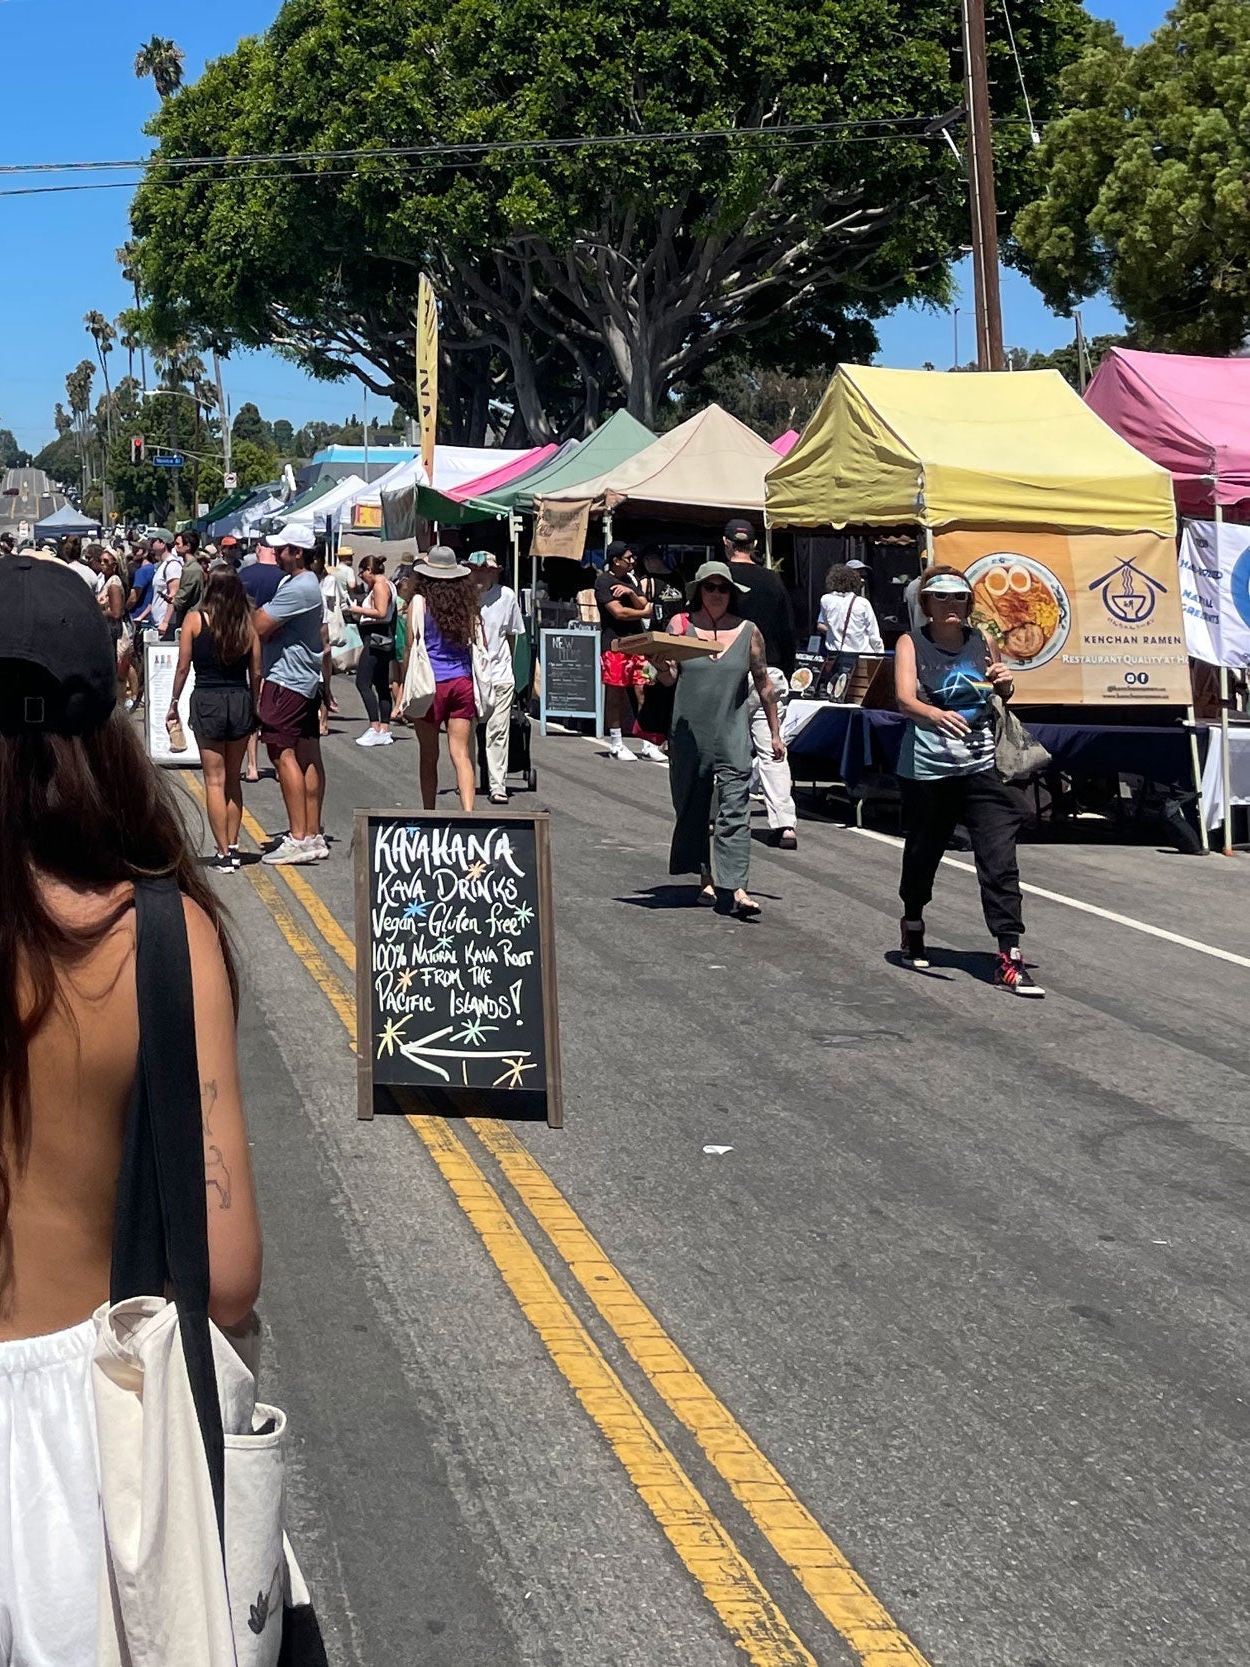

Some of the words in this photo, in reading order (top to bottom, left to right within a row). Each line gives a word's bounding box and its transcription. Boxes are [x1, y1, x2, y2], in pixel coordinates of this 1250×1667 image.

[552, 636, 574, 649] NEW
[1084, 635, 1139, 645] KENCHAN
[1143, 635, 1181, 645] RAMEN
[1062, 653, 1122, 664] RESTAURANT
[1123, 654, 1162, 667] QUALITY
[373, 820, 525, 878] KAVAHANA
[377, 868, 427, 904] KAVA
[432, 869, 518, 909] DRINKS
[485, 905, 522, 937] free
[372, 941, 407, 973] 100%
[411, 935, 458, 966] NATURAL
[464, 941, 499, 966] KAVA
[497, 939, 535, 968] ROOT
[420, 966, 464, 991] FROM
[375, 970, 436, 1014] PACIFIC
[450, 978, 524, 1026] ISLANDS!
